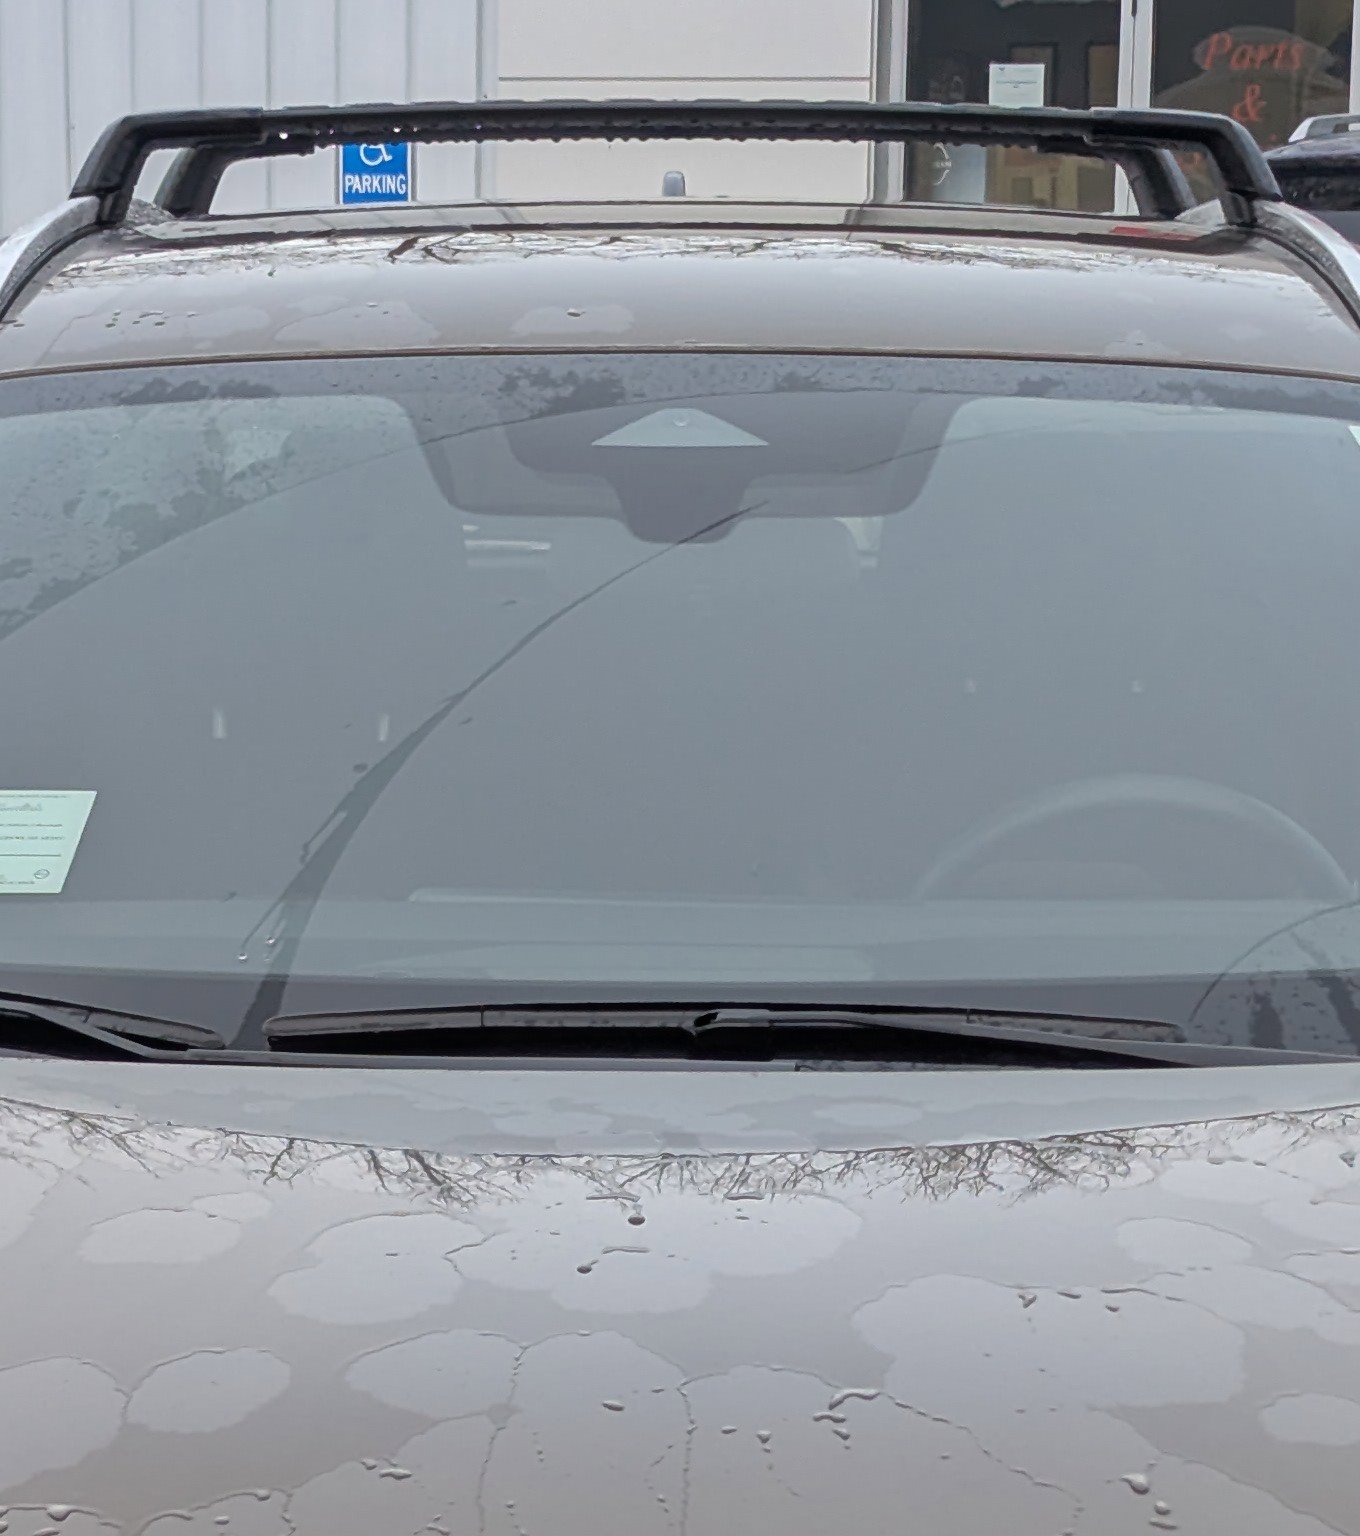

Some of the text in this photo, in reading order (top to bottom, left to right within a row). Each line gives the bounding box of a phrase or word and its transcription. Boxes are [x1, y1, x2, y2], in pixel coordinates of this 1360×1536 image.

[1203, 33, 1306, 71] Parts
[1232, 83, 1267, 122] &
[344, 174, 407, 195] PARKING
